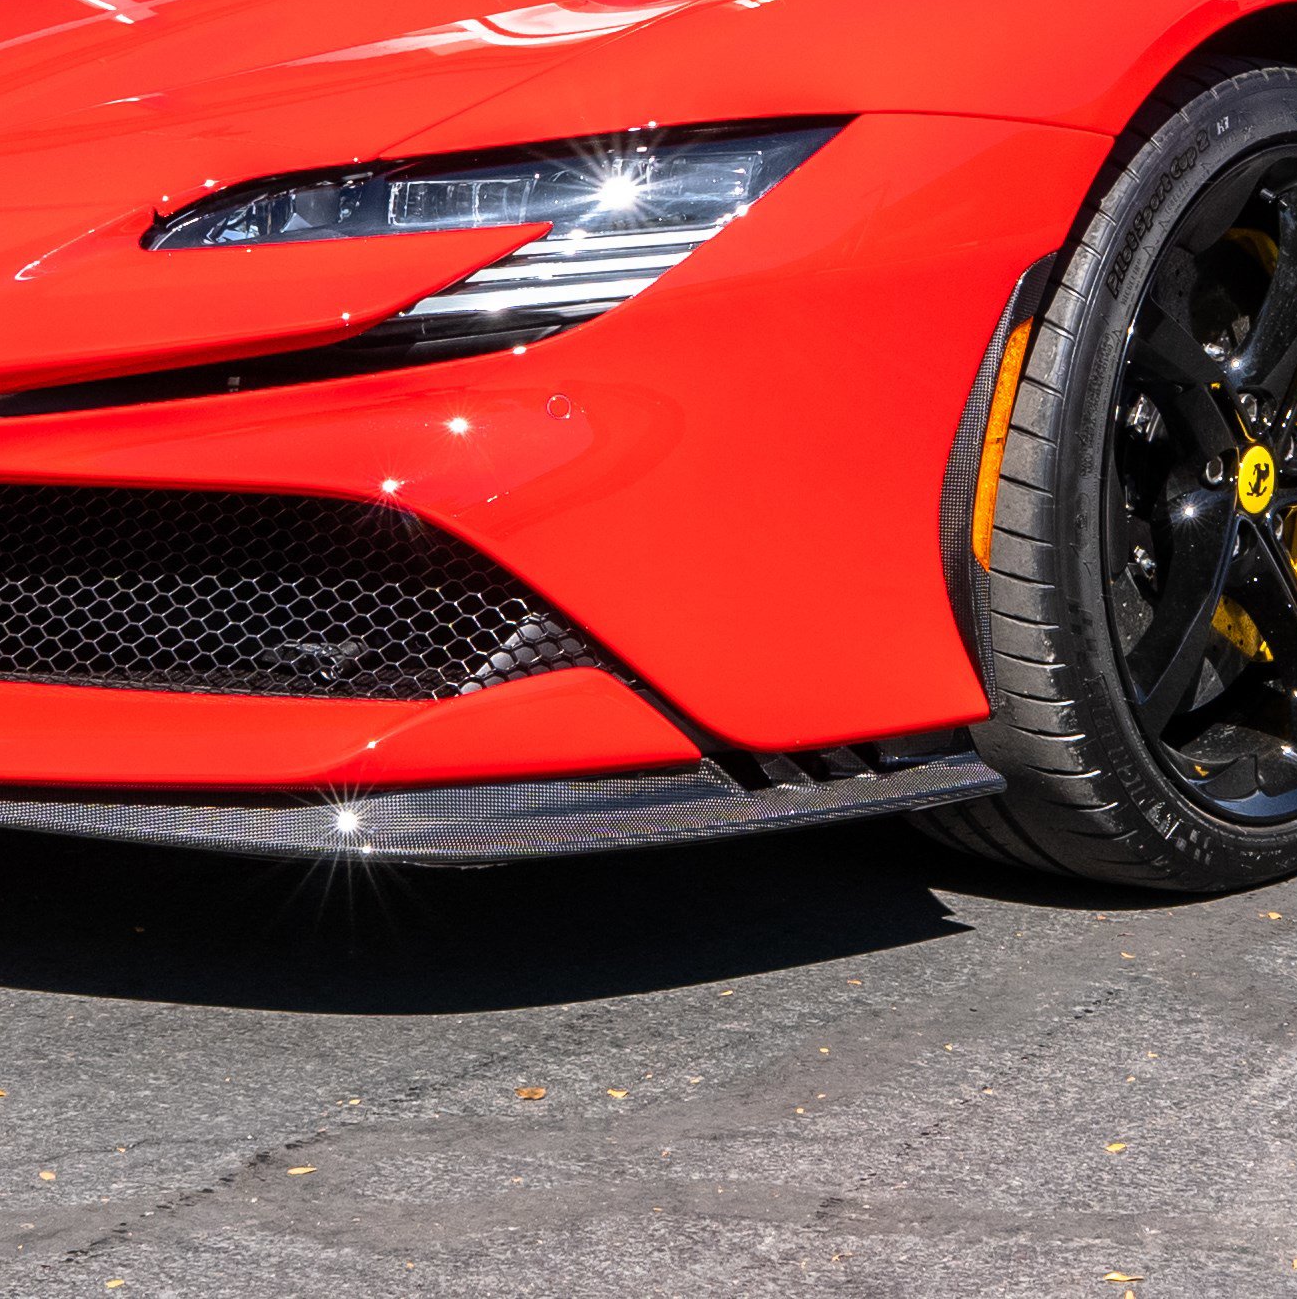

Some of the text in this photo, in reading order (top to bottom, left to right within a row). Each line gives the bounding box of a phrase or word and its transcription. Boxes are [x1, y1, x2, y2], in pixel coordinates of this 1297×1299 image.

[1133, 173, 1173, 242] Sport
[1169, 146, 1198, 181] Cup
[1195, 129, 1211, 153] 2
